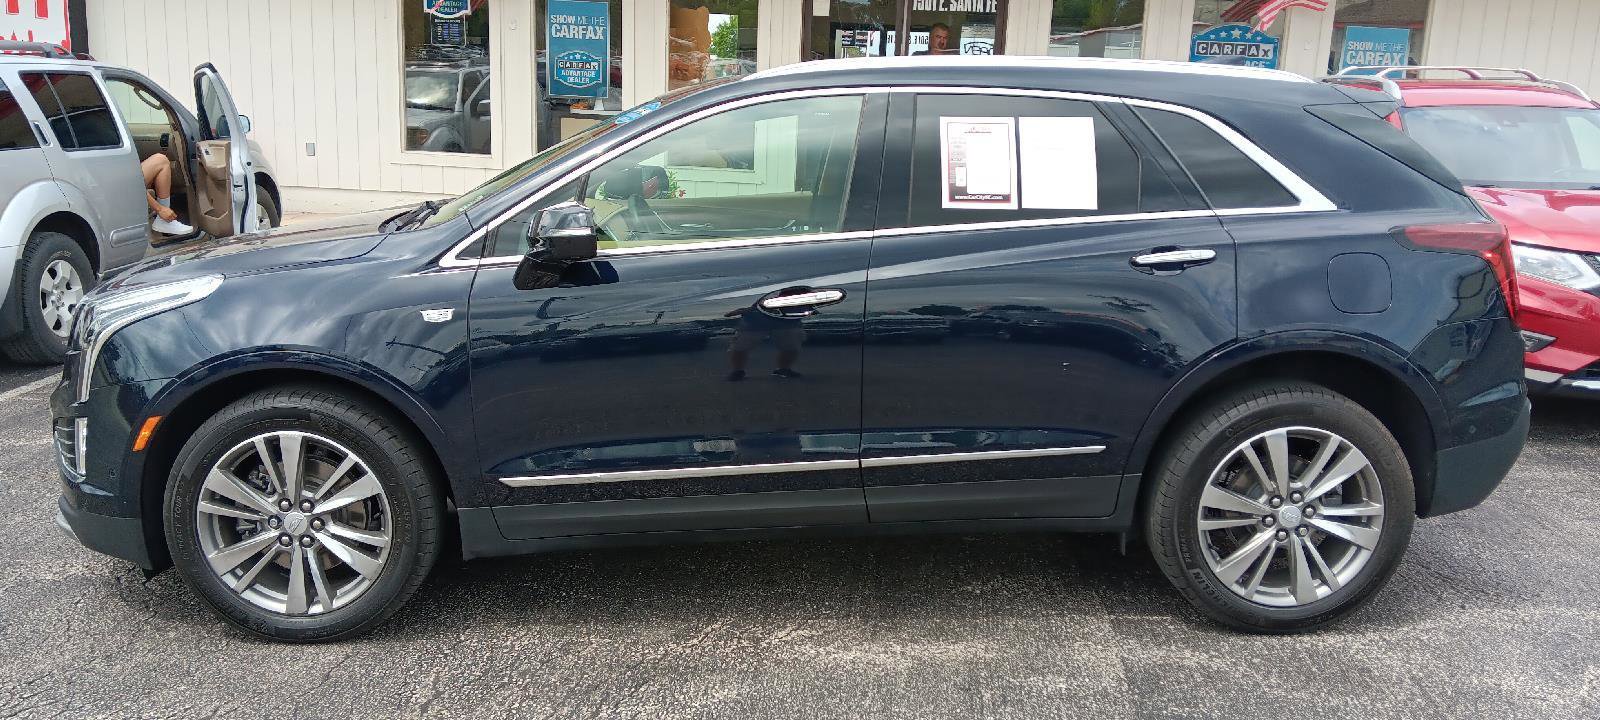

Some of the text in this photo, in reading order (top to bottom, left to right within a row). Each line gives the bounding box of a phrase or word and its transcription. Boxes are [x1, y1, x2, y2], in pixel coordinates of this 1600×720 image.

[949, 0, 984, 12] SANTA
[985, 0, 998, 13] FE
[551, 15, 605, 26] SHOW ME THE
[551, 23, 606, 40] CARFAX
[1197, 43, 1271, 58] CARFAX
[1348, 40, 1405, 53] SHOW ME THE
[1346, 50, 1405, 66] CARFAX
[559, 61, 598, 70] CARFAX
[561, 70, 596, 78] ADVANTAGE
